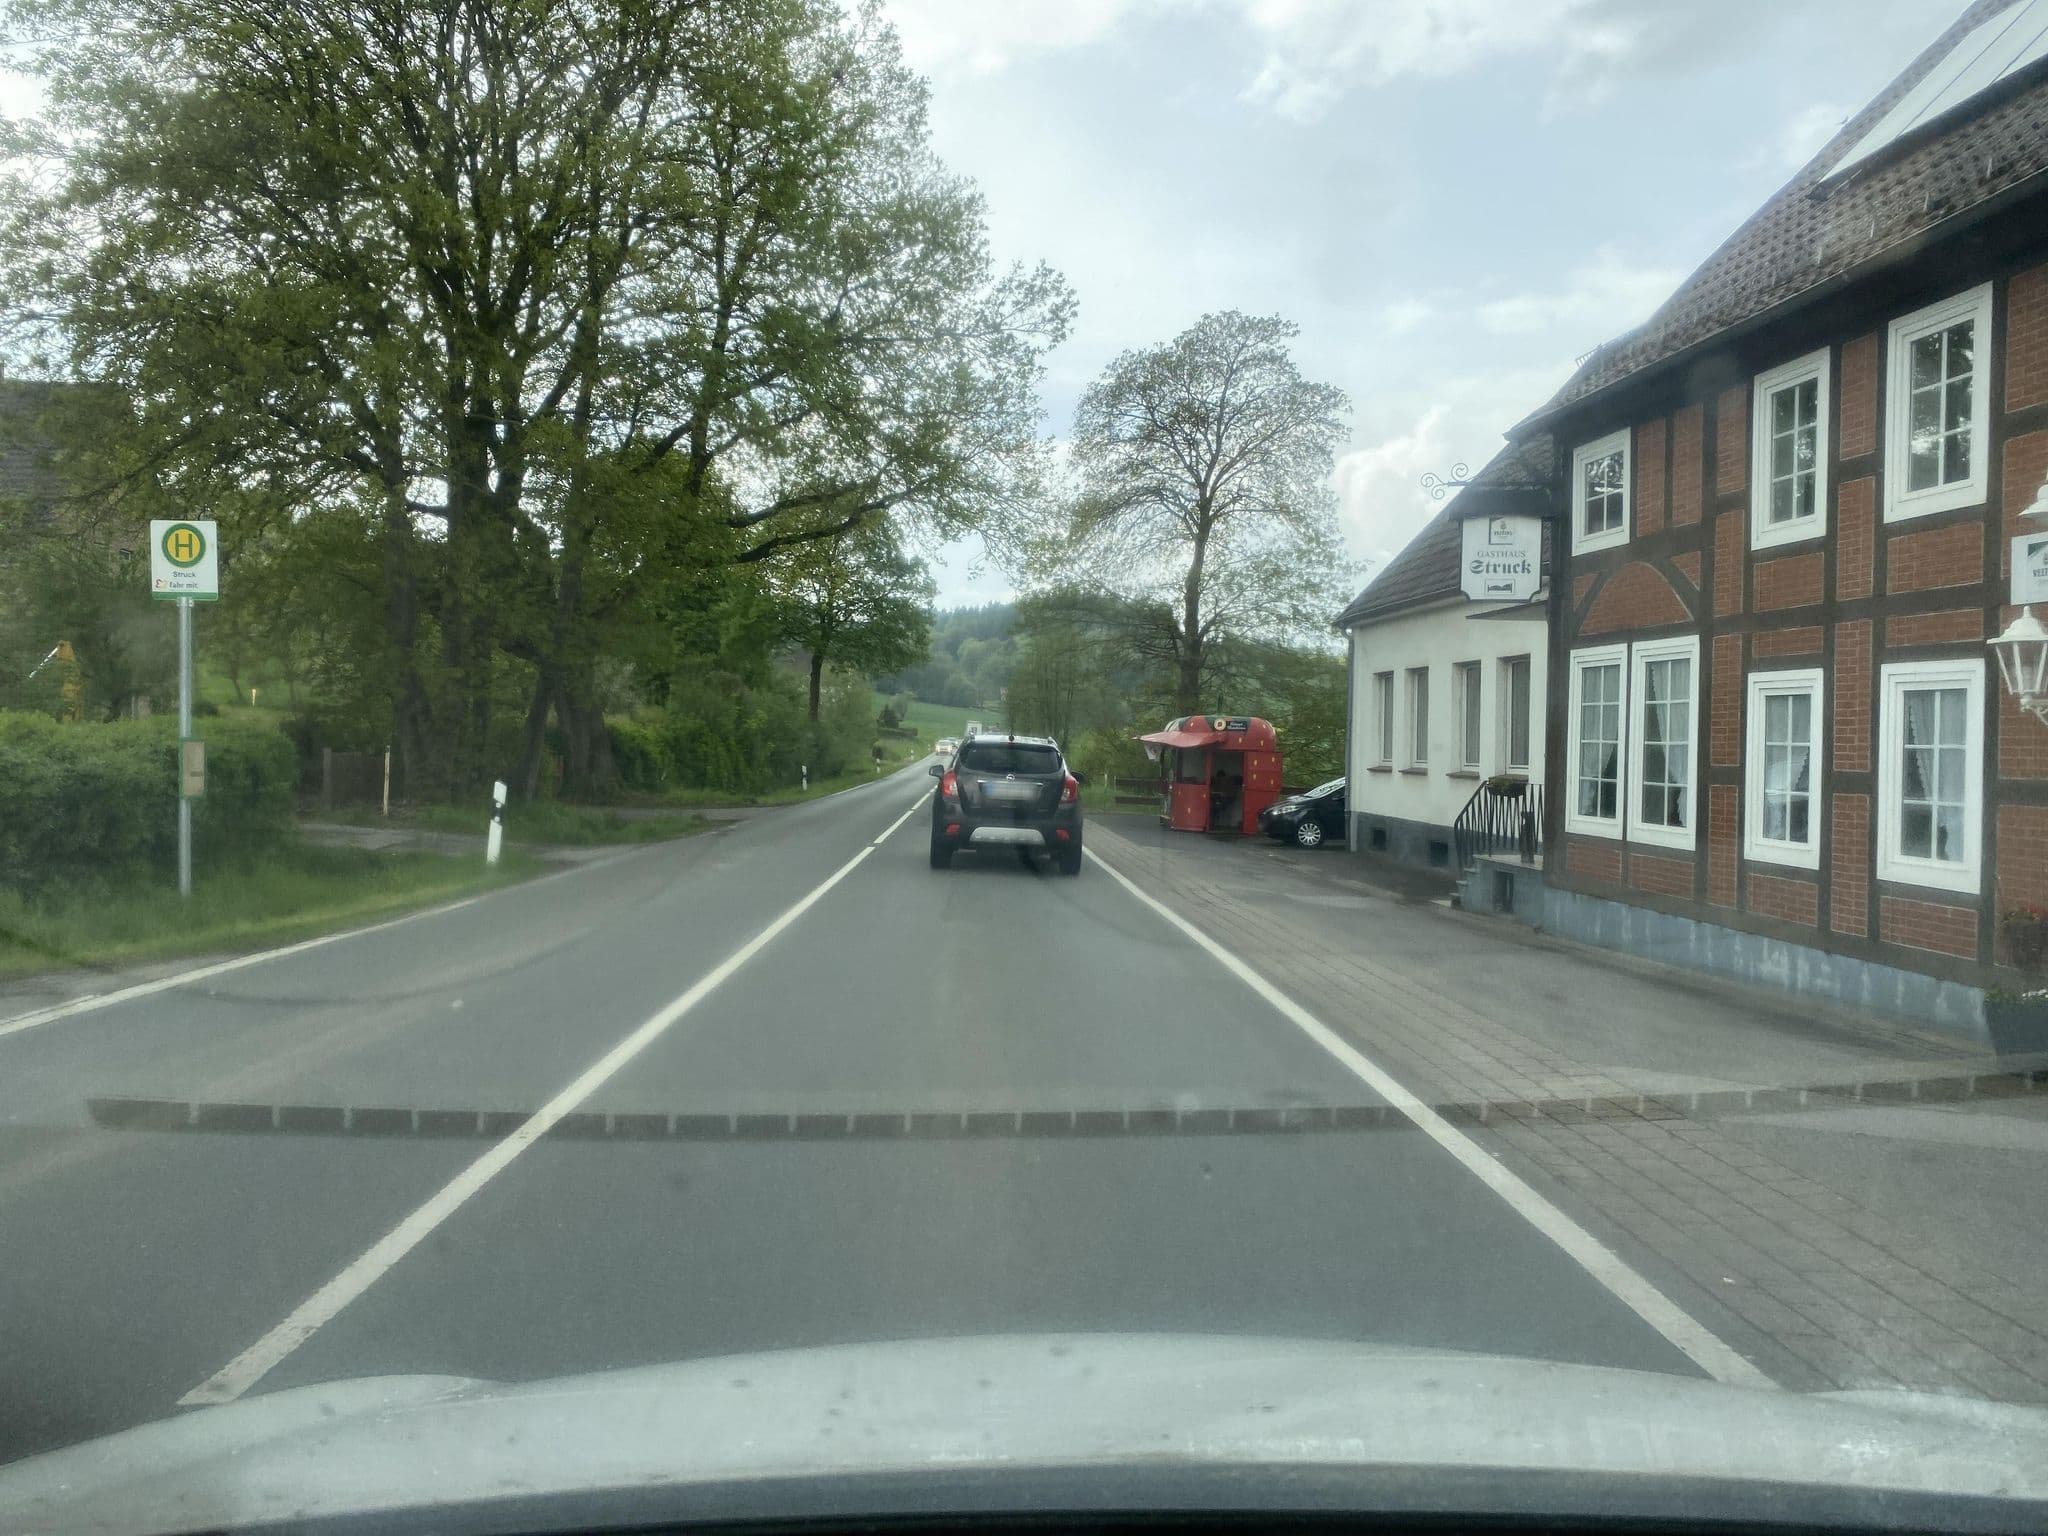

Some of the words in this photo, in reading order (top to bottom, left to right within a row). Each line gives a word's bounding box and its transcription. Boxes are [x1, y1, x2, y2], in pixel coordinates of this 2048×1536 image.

[175, 533, 193, 558] H
[1477, 550, 1526, 558] GASTHAUS
[1470, 559, 1532, 574] Struck
[172, 570, 196, 578] Struck
[169, 581, 184, 589] fahr
